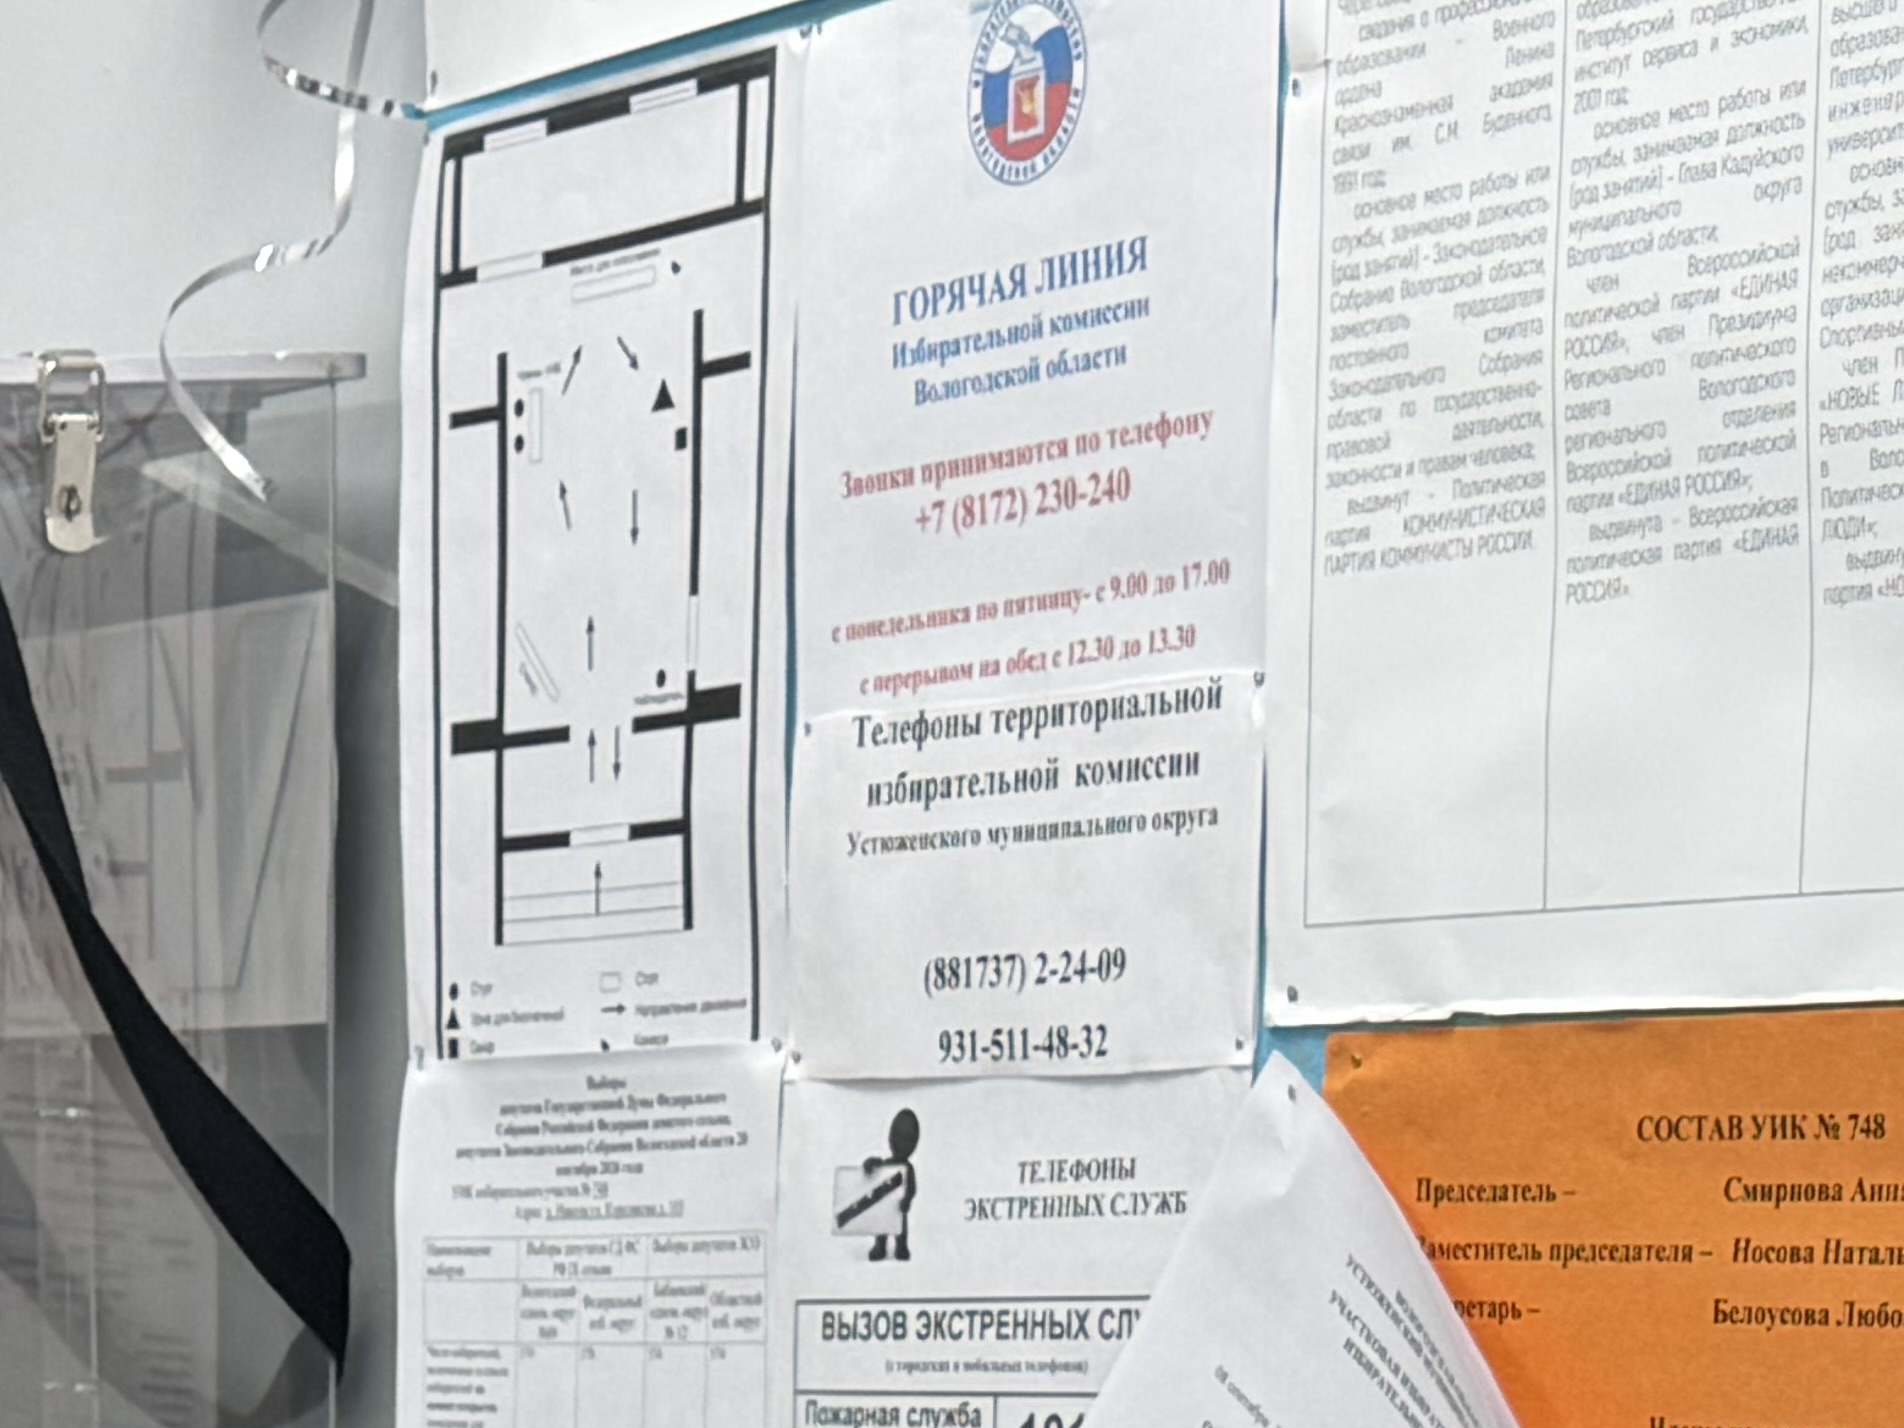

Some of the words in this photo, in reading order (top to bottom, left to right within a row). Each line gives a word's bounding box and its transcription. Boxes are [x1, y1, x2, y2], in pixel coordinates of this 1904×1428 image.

[1719, 87, 1771, 118] работы
[893, 264, 1028, 326] ГОРЯЧАЯ
[1035, 236, 1148, 295] ЛИНИЯ
[893, 313, 1043, 370] Избирательной
[1050, 297, 1149, 335] комиссии
[915, 356, 1040, 406] Вологодской
[1047, 344, 1127, 386] области
[842, 470, 915, 500] Звонки
[922, 436, 1069, 490] принимаются
[1076, 433, 1100, 456] по
[1107, 409, 1214, 449] телефону
[915, 501, 946, 535] +7
[952, 486, 1028, 537] (8172)
[1036, 467, 1131, 517] 230-240
[832, 624, 840, 643] с
[846, 607, 971, 642] понедельника
[976, 600, 998, 622] по
[1096, 583, 1105, 603] с
[1110, 572, 1148, 599] 9.00
[1153, 573, 1176, 597] до
[1182, 559, 1230, 592] 17.00
[860, 676, 869, 696] с
[873, 662, 973, 697] перерывом
[978, 657, 1000, 678] на
[1006, 648, 1047, 676] обед
[1053, 648, 1062, 668] с
[1067, 636, 1113, 665] 12.30
[1118, 637, 1141, 661] до
[1147, 623, 1196, 654] 13.30
[853, 707, 981, 752] Телефоны
[990, 677, 1223, 740] территориальной
[867, 758, 1059, 811] избирательной
[1076, 750, 1200, 788] комиссии
[847, 826, 981, 857] Устюженского
[988, 811, 1147, 852] муниципального
[1152, 802, 1219, 836] округа
[924, 954, 1026, 998] (881737)
[1034, 947, 1126, 986] 2-24-09
[938, 1024, 1109, 1064] 931-511-48-32
[1637, 1114, 1744, 1142] СОСТАВ
[1750, 1112, 1807, 1141] УИК
[1813, 1113, 1841, 1142] №
[1848, 1112, 1886, 1141] 748
[1018, 1157, 1137, 1185] ТЕЛЕФОНЫ
[1416, 1176, 1557, 1208] Председатель
[1723, 1176, 1844, 1209] Смирнова
[1850, 1176, 1904, 1203] Анн
[964, 1195, 1105, 1221] ЭКСТРЕННЫХ
[1109, 1191, 1189, 1216] СЛУЖБ
[1418, 1235, 1542, 1262] аместитель
[1549, 1243, 1693, 1270] председателя
[1732, 1237, 1814, 1265] Носова
[821, 1309, 908, 1342] ВЫЗОВ
[916, 1308, 1090, 1342] ЭКСТРЕННЫХ
[1098, 1308, 1142, 1342] СЛ
[1452, 1300, 1523, 1327] ретарь
[1713, 1298, 1830, 1333] Белоусова
